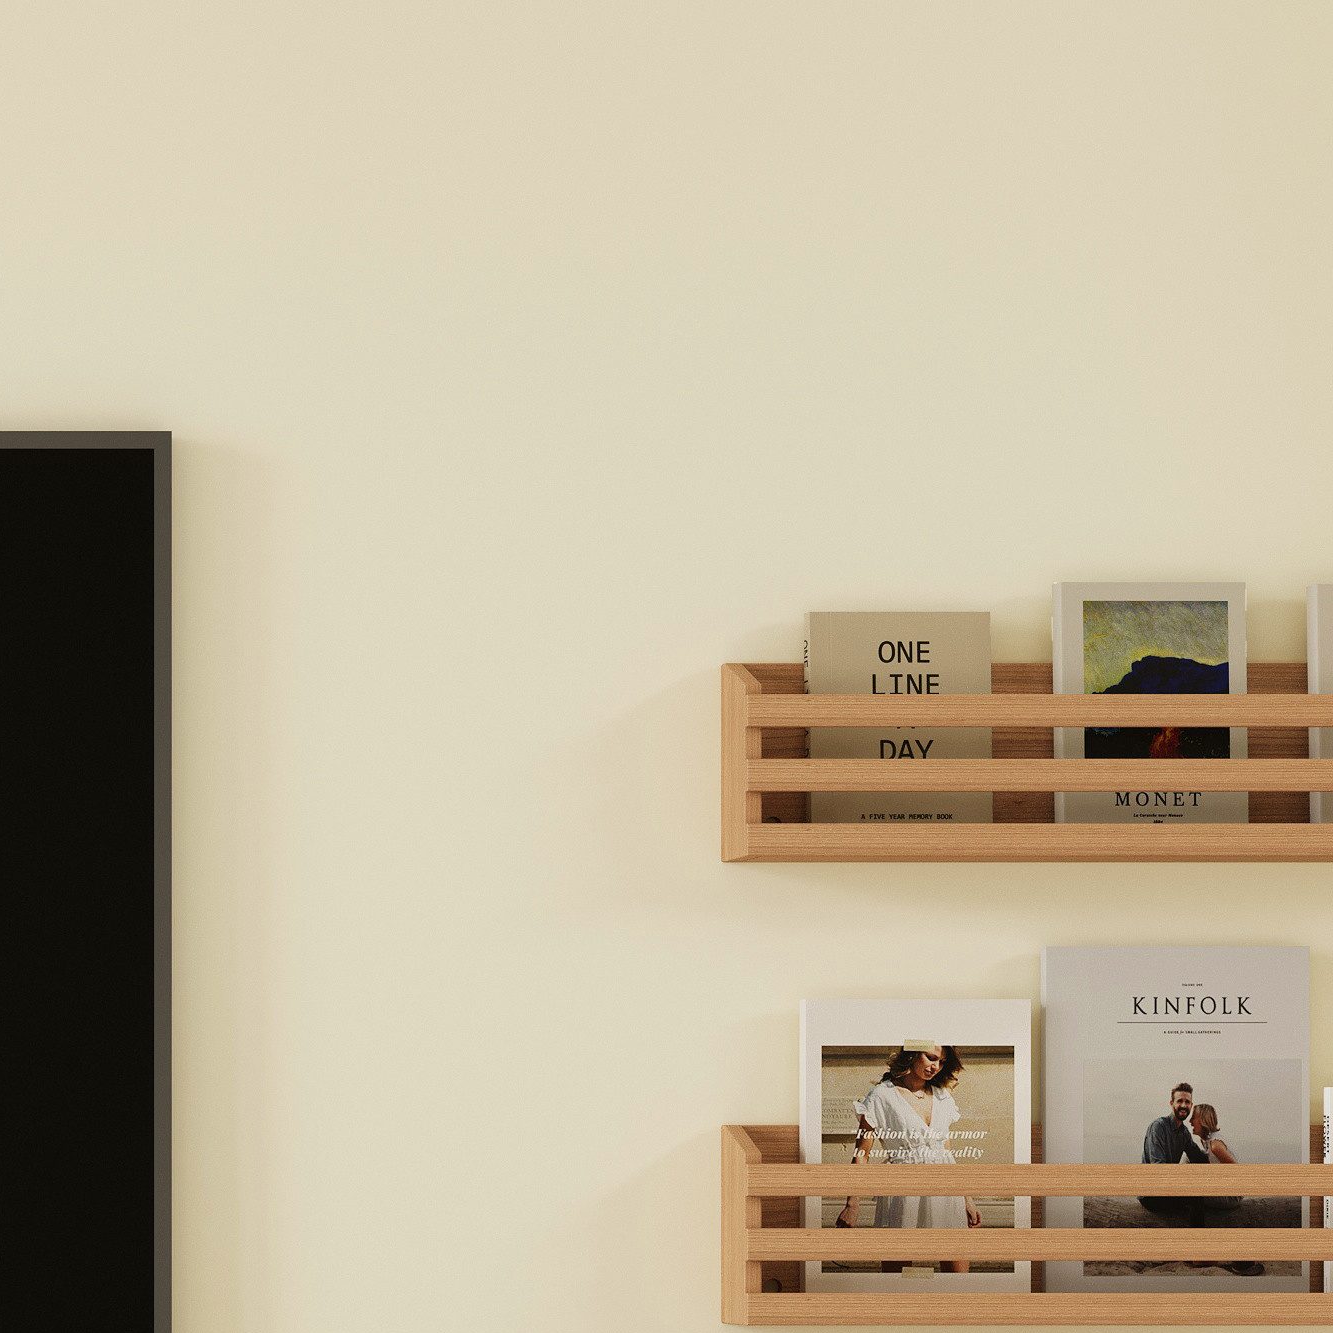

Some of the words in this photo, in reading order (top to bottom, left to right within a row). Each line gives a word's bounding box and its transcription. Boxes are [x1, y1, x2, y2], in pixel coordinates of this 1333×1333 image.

[878, 640, 930, 663] ONE
[872, 674, 940, 694] LINE
[880, 739, 934, 759] DAY
[1115, 791, 1202, 807] MONET
[1133, 996, 1252, 1015] KINFOLK
[945, 1130, 987, 1140] armor
[853, 1147, 865, 1158] to
